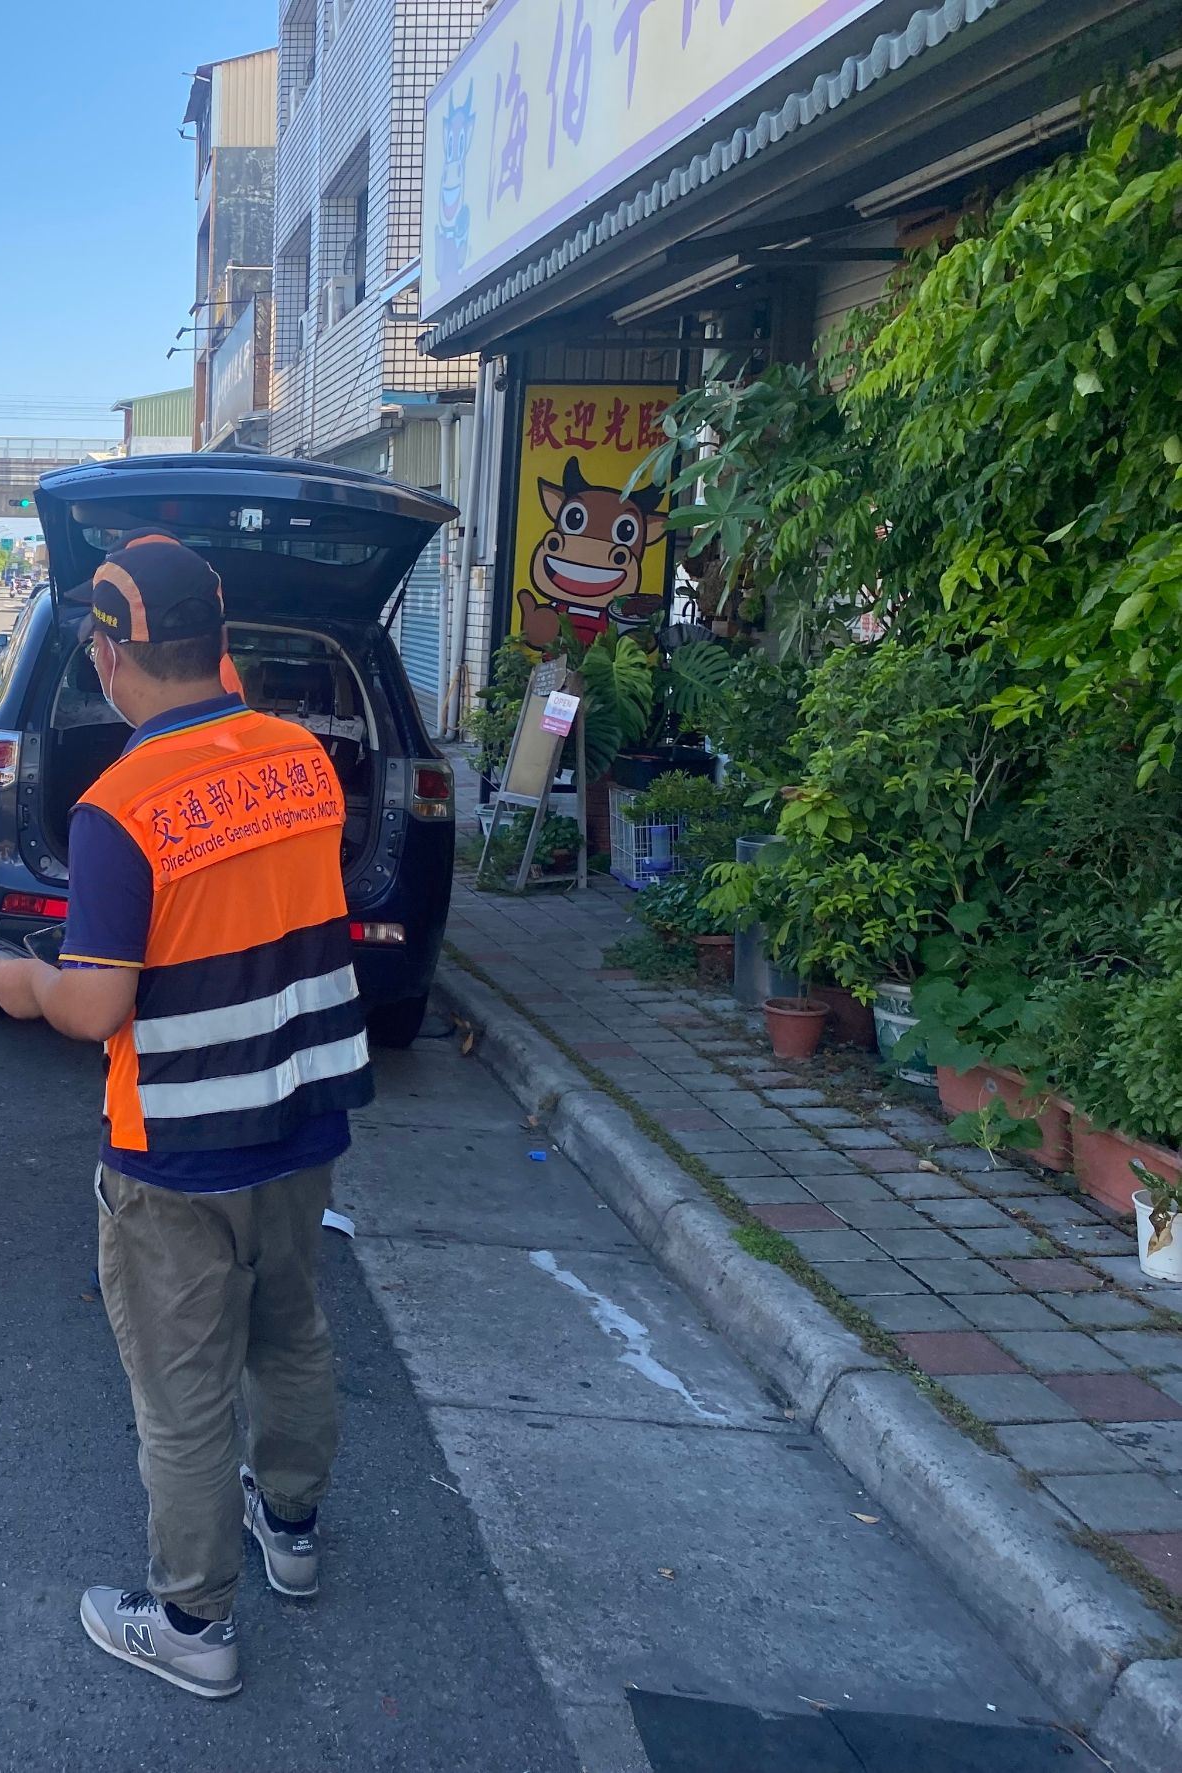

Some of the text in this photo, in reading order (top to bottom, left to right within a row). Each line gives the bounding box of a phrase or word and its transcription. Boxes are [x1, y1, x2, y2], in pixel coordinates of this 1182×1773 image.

[486, 0, 735, 221] 海伯
[526, 396, 671, 451] 歡迎光臨
[151, 757, 333, 852] 交通部公路總局
[161, 836, 226, 873] Directorate
[224, 817, 262, 843] General
[262, 814, 274, 831] of
[124, 1622, 156, 1656] N
